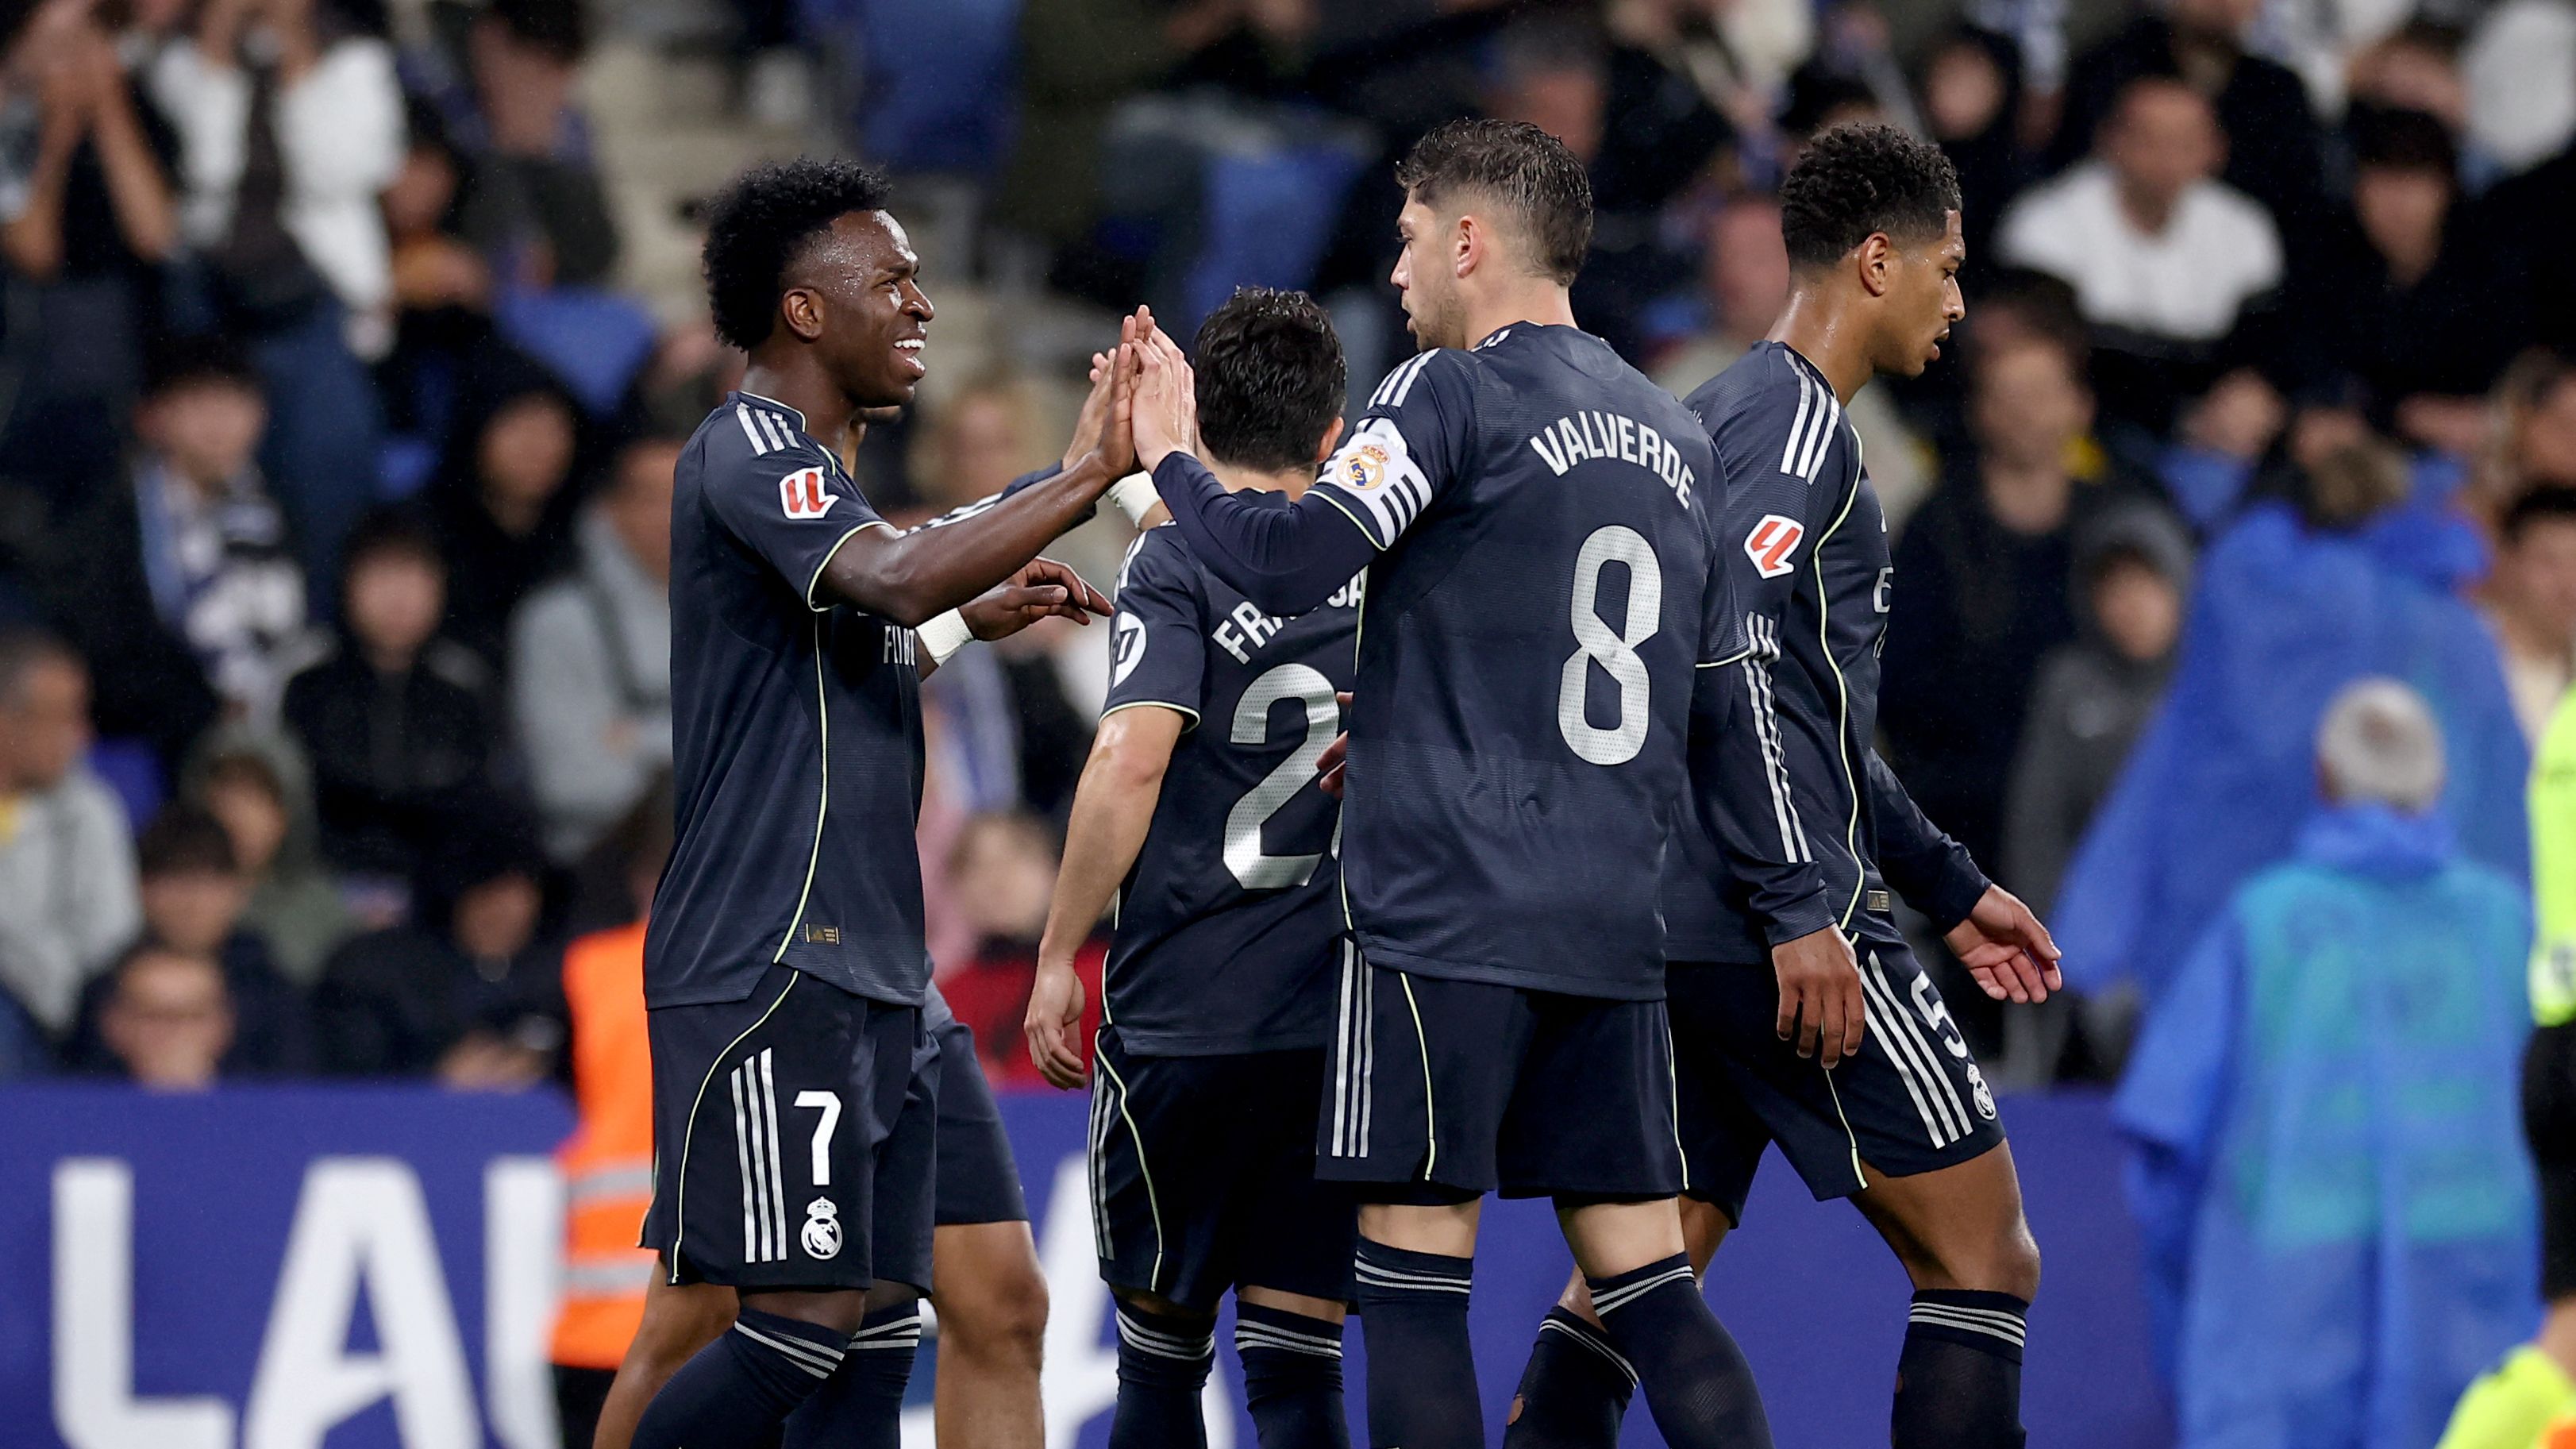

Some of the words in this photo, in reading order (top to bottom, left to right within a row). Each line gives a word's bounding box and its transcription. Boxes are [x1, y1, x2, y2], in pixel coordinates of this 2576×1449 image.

[1529, 410, 1696, 510] VALVERDE
[1558, 524, 1663, 766] 8
[1223, 662, 1345, 890] 2
[1910, 969, 1968, 1059] 5
[793, 1089, 842, 1186] 7
